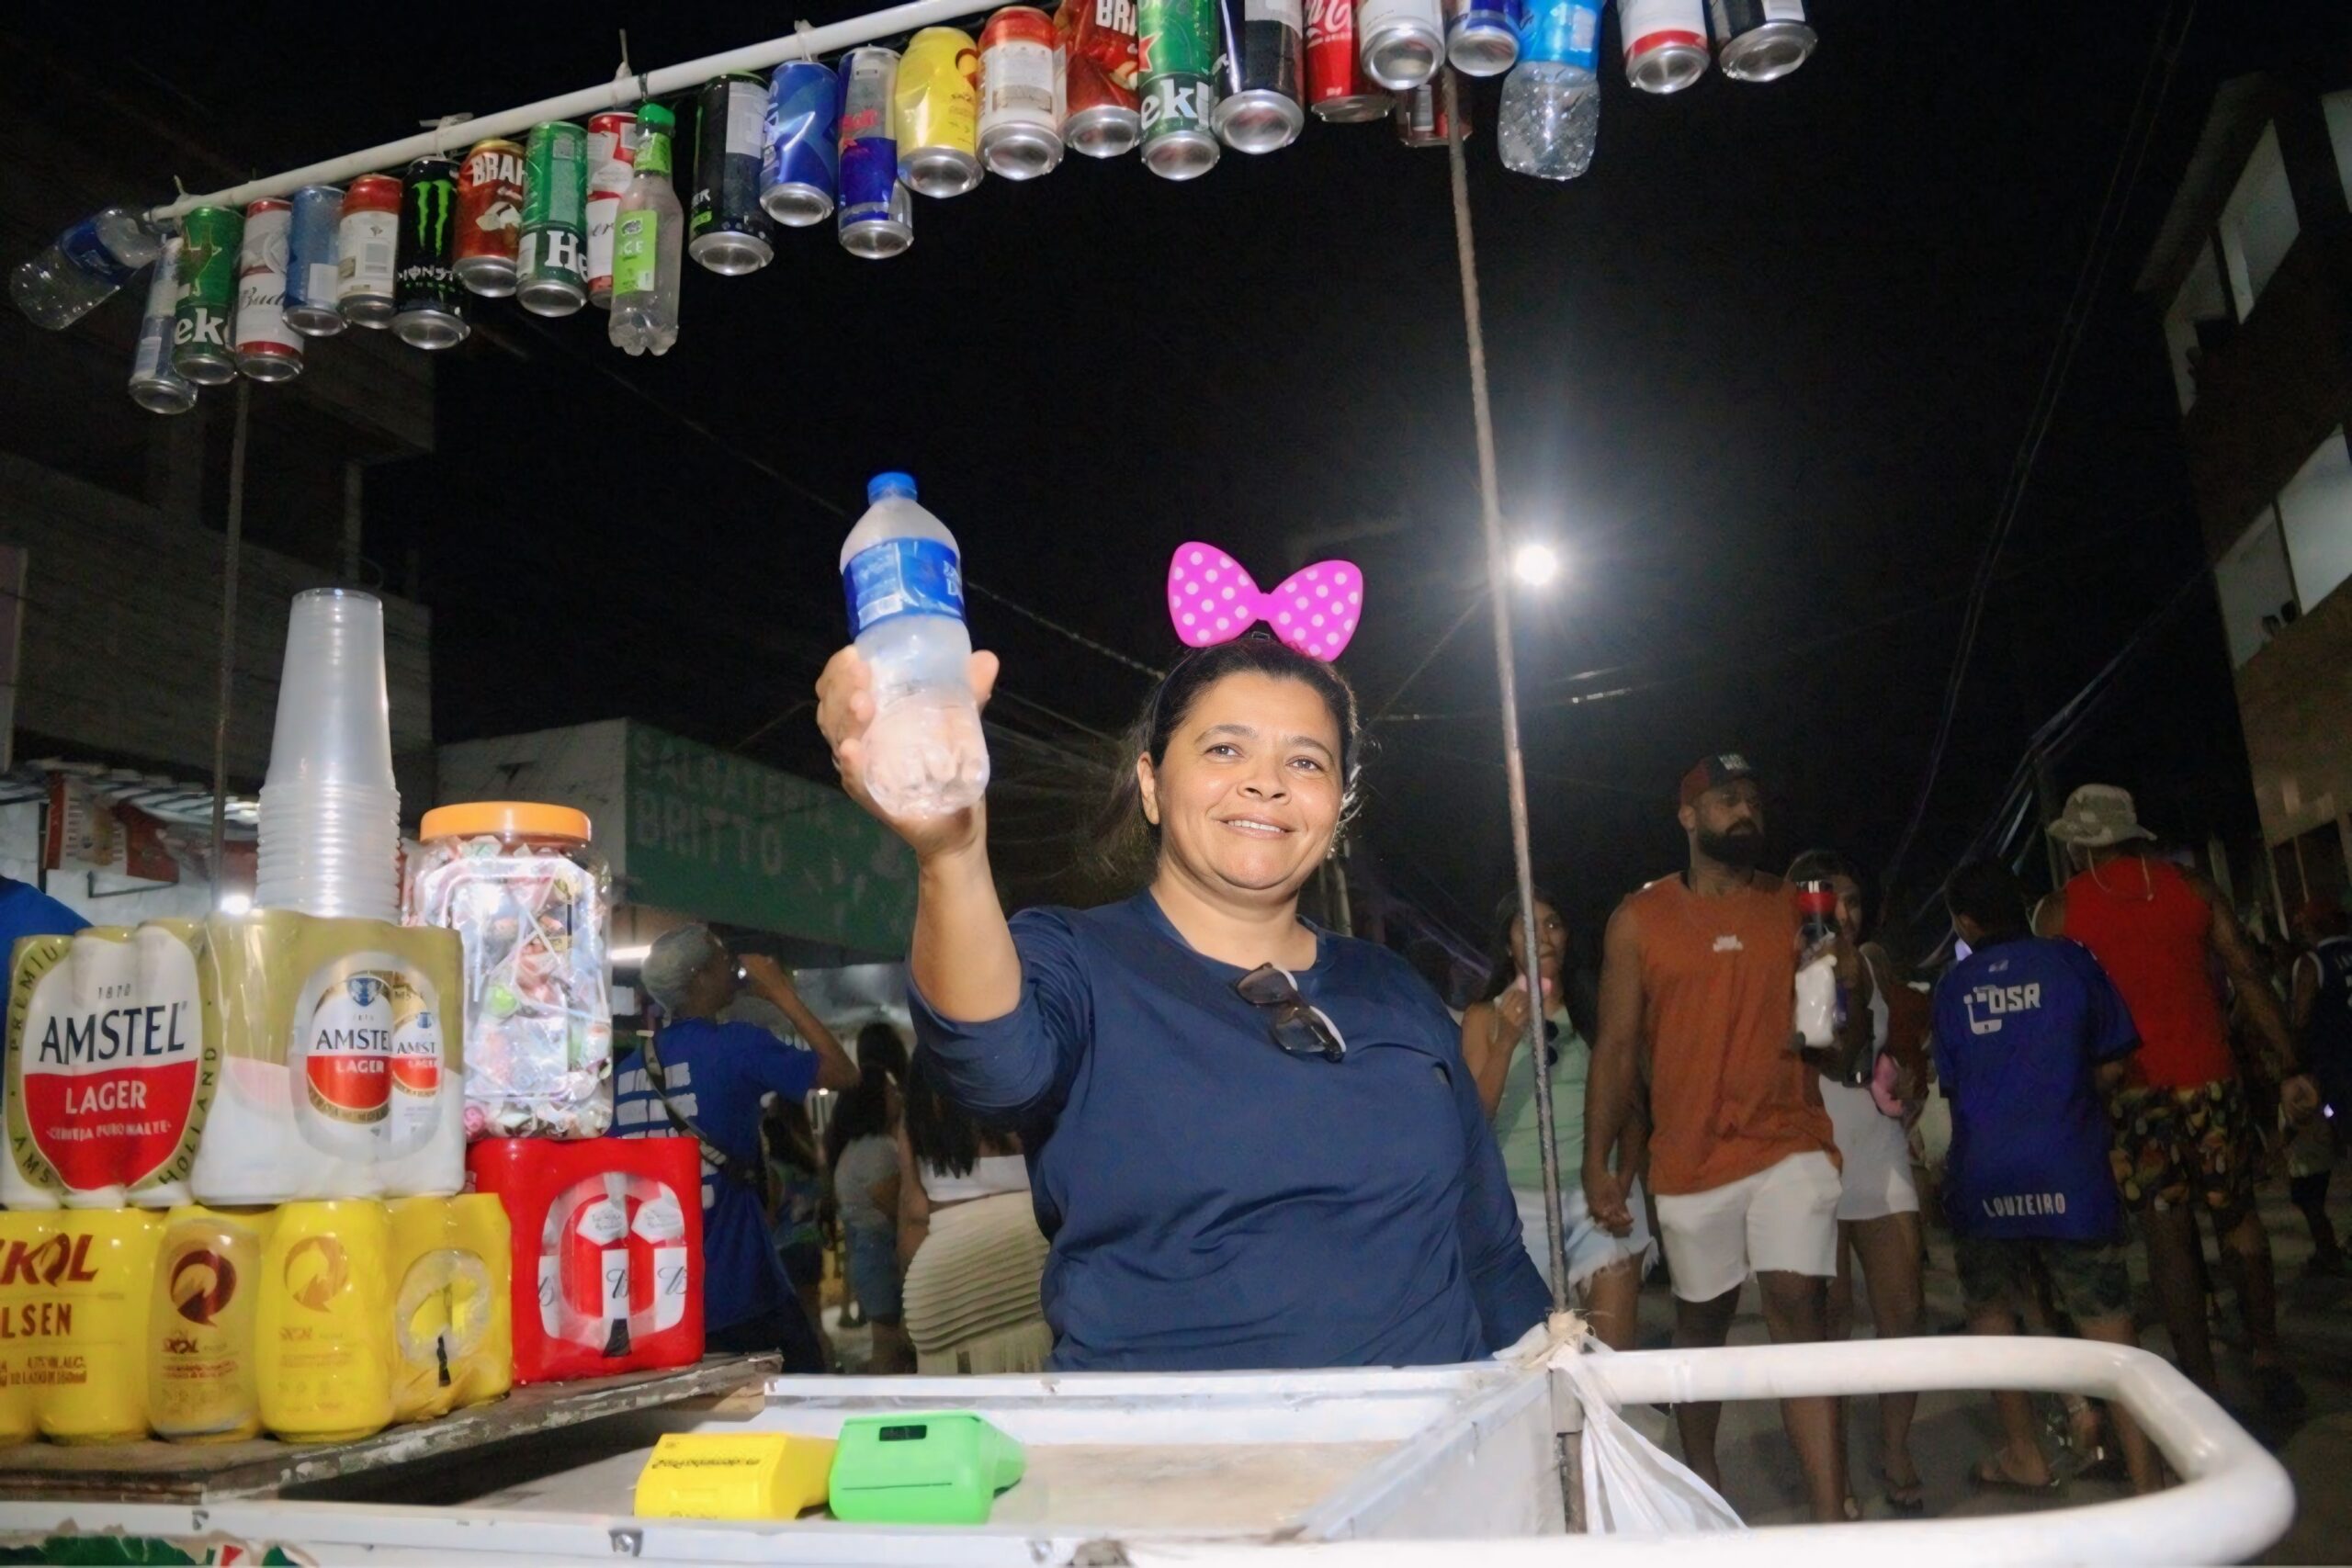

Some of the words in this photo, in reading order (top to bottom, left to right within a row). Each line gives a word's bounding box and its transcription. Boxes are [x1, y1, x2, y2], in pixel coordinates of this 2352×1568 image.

[39, 1002, 186, 1066] AMSTEL
[315, 1028, 393, 1052] AMSTE
[65, 1080, 147, 1115] LAGER
[1983, 1192, 2066, 1219] LOUZEIRO
[0, 1232, 99, 1288] KOL
